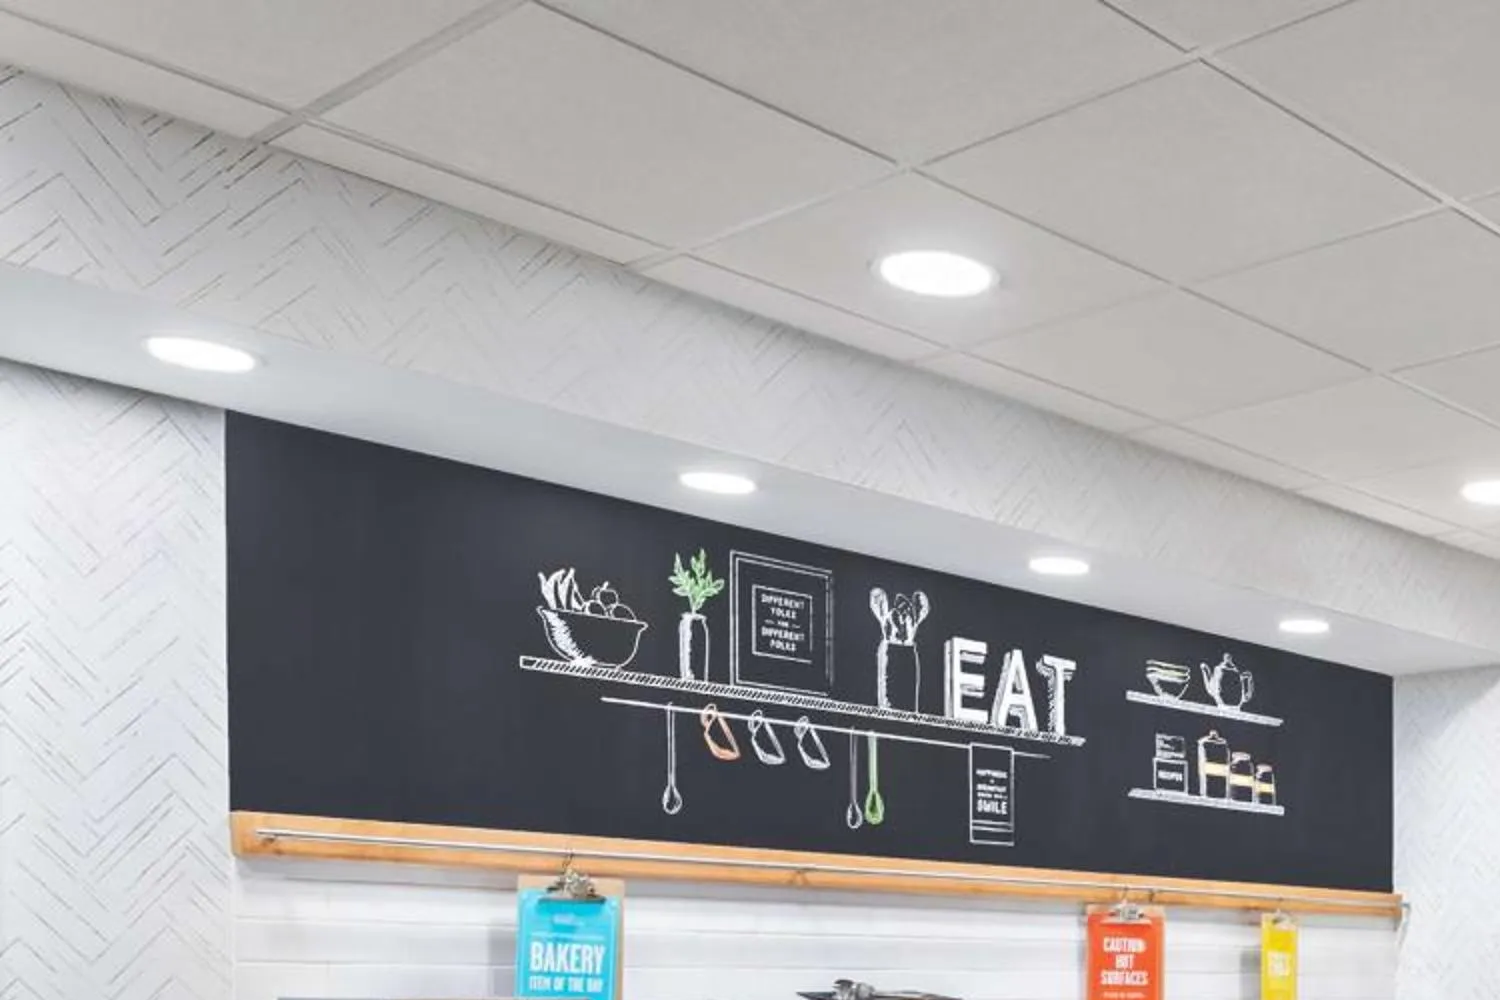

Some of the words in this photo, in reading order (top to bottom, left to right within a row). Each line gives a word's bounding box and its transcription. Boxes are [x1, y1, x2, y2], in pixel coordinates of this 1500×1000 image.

[944, 636, 1077, 736] EAT
[529, 941, 607, 975] BAKERY
[1115, 953, 1134, 969] HOT
[1100, 970, 1149, 986] SURFACES
